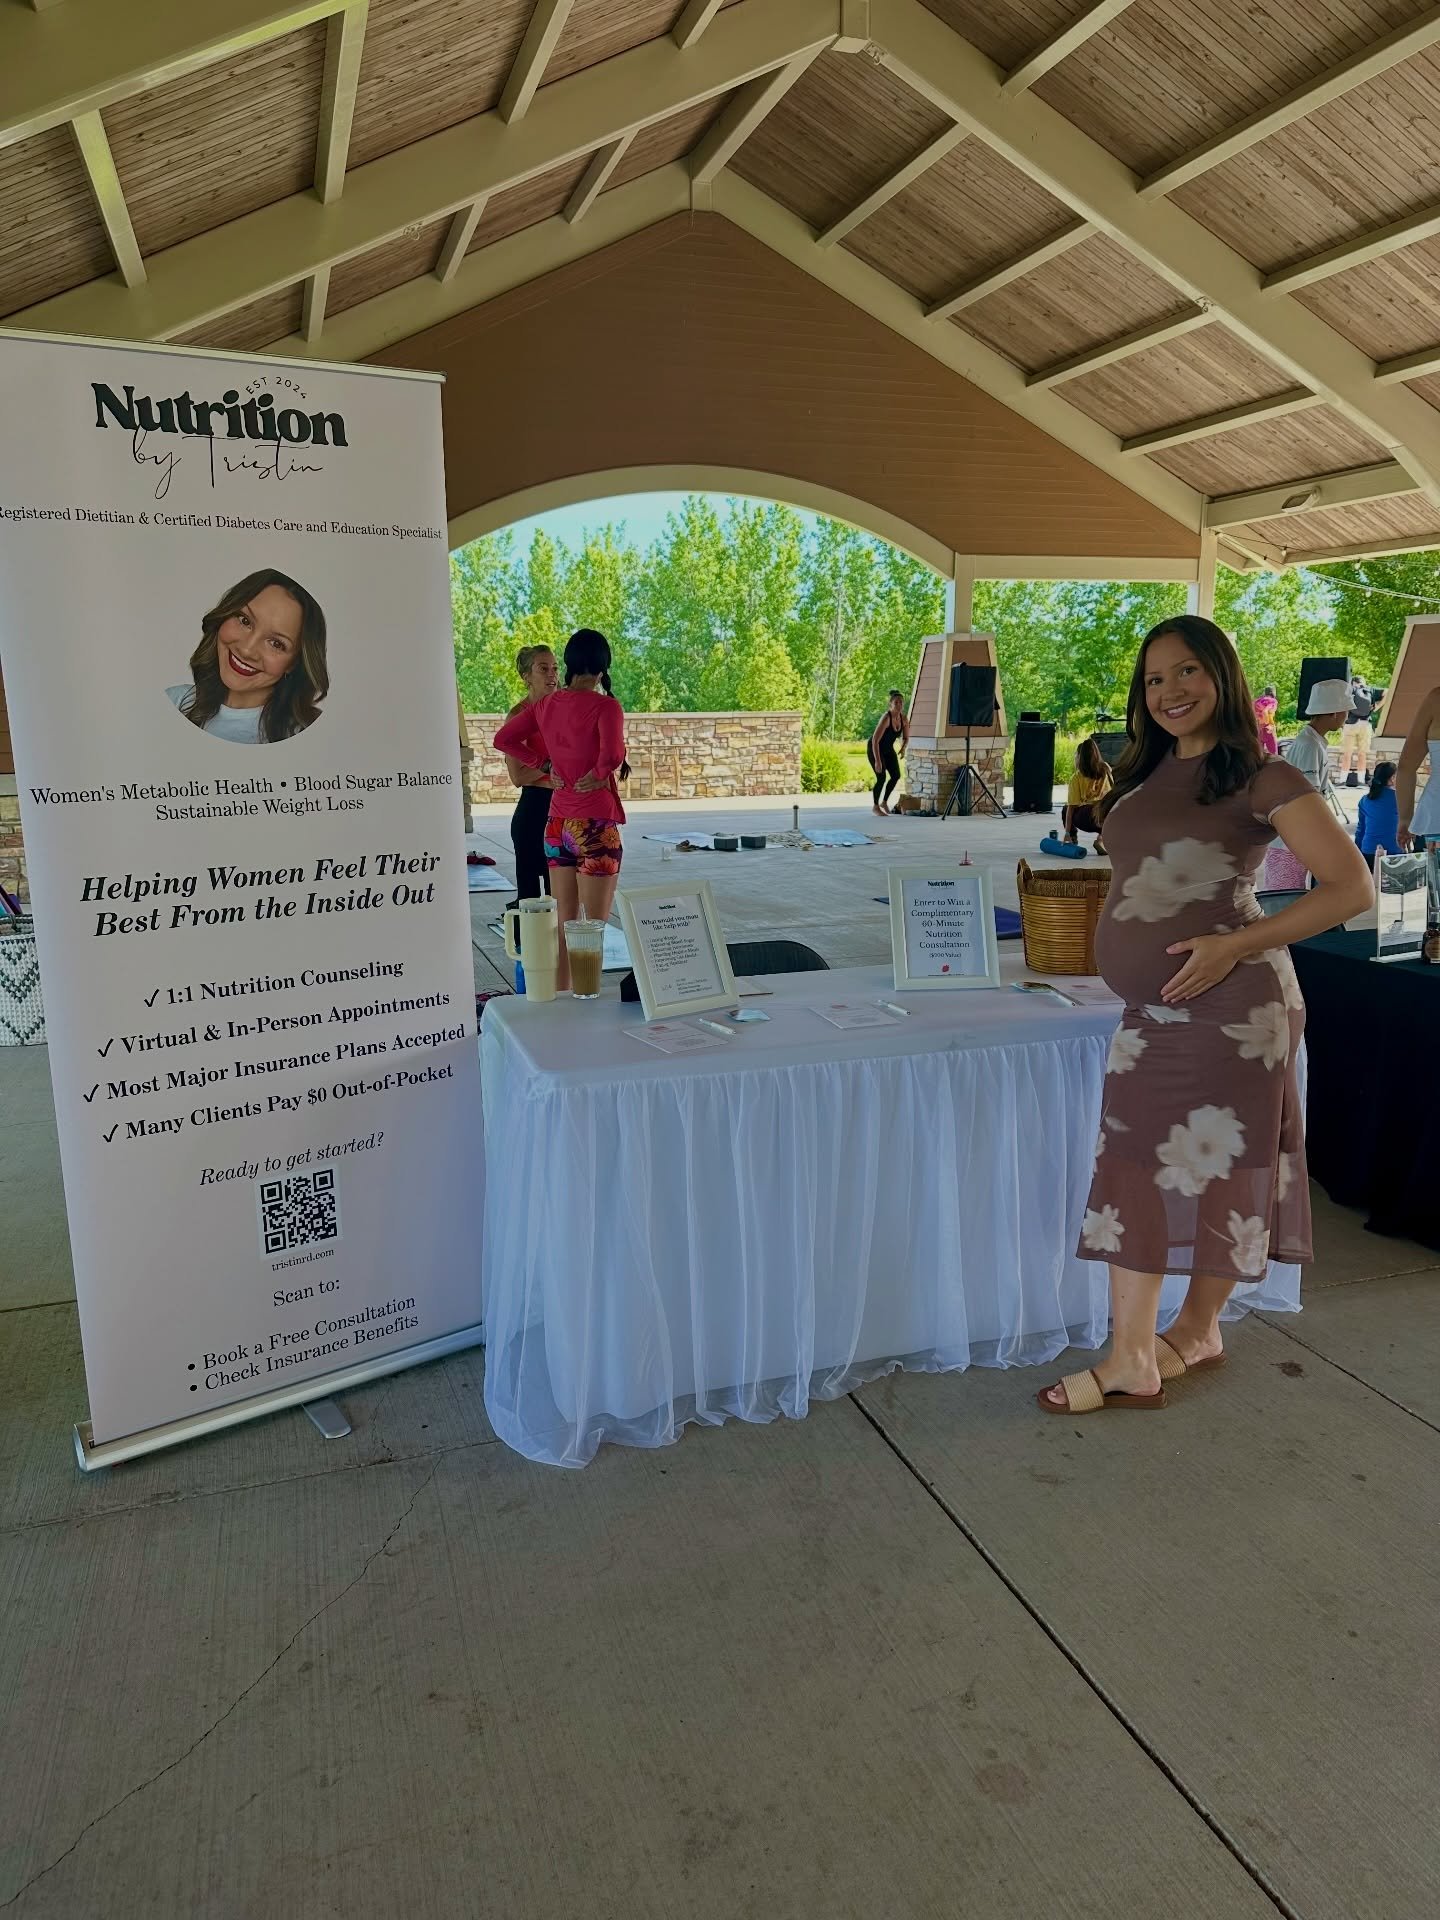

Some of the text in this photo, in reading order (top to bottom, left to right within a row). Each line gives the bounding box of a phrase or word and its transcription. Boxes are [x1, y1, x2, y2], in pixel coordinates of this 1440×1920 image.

[246, 377, 307, 399] EST 2024
[90, 382, 348, 447] Nutrition
[132, 425, 182, 500] by
[75, 509, 135, 523] Dietitian
[139, 512, 149, 524] &
[154, 513, 211, 526] Certified
[215, 516, 270, 529] Diabetes
[274, 519, 302, 531] Care
[306, 521, 327, 532] and
[330, 522, 389, 535] Education
[392, 525, 441, 539] Specialist
[29, 772, 452, 804] Women's Metabolic Health Blood Sugar Balance
[156, 796, 364, 820] Sustainable Weight Loss
[80, 852, 440, 902] Helping Women Feel Their
[93, 883, 435, 936] Best From the Inside Out
[911, 909, 974, 918] Complimentary
[167, 961, 404, 1004] 1:1 Nutrition Counseling
[120, 992, 449, 1053] Virtual & In-Person Appointments
[106, 1024, 465, 1099] Most Major Insurance Plans Accepted
[125, 1064, 453, 1139] Many Clients Pay $0 Out-of-Pocket
[200, 1132, 384, 1185] Ready to get started?
[272, 1250, 334, 1271] tristinrd.com
[274, 1280, 339, 1307] Scan to:
[203, 1297, 416, 1369] Book a Free Consultation
[205, 1314, 419, 1389] Check Insurance Benefits
